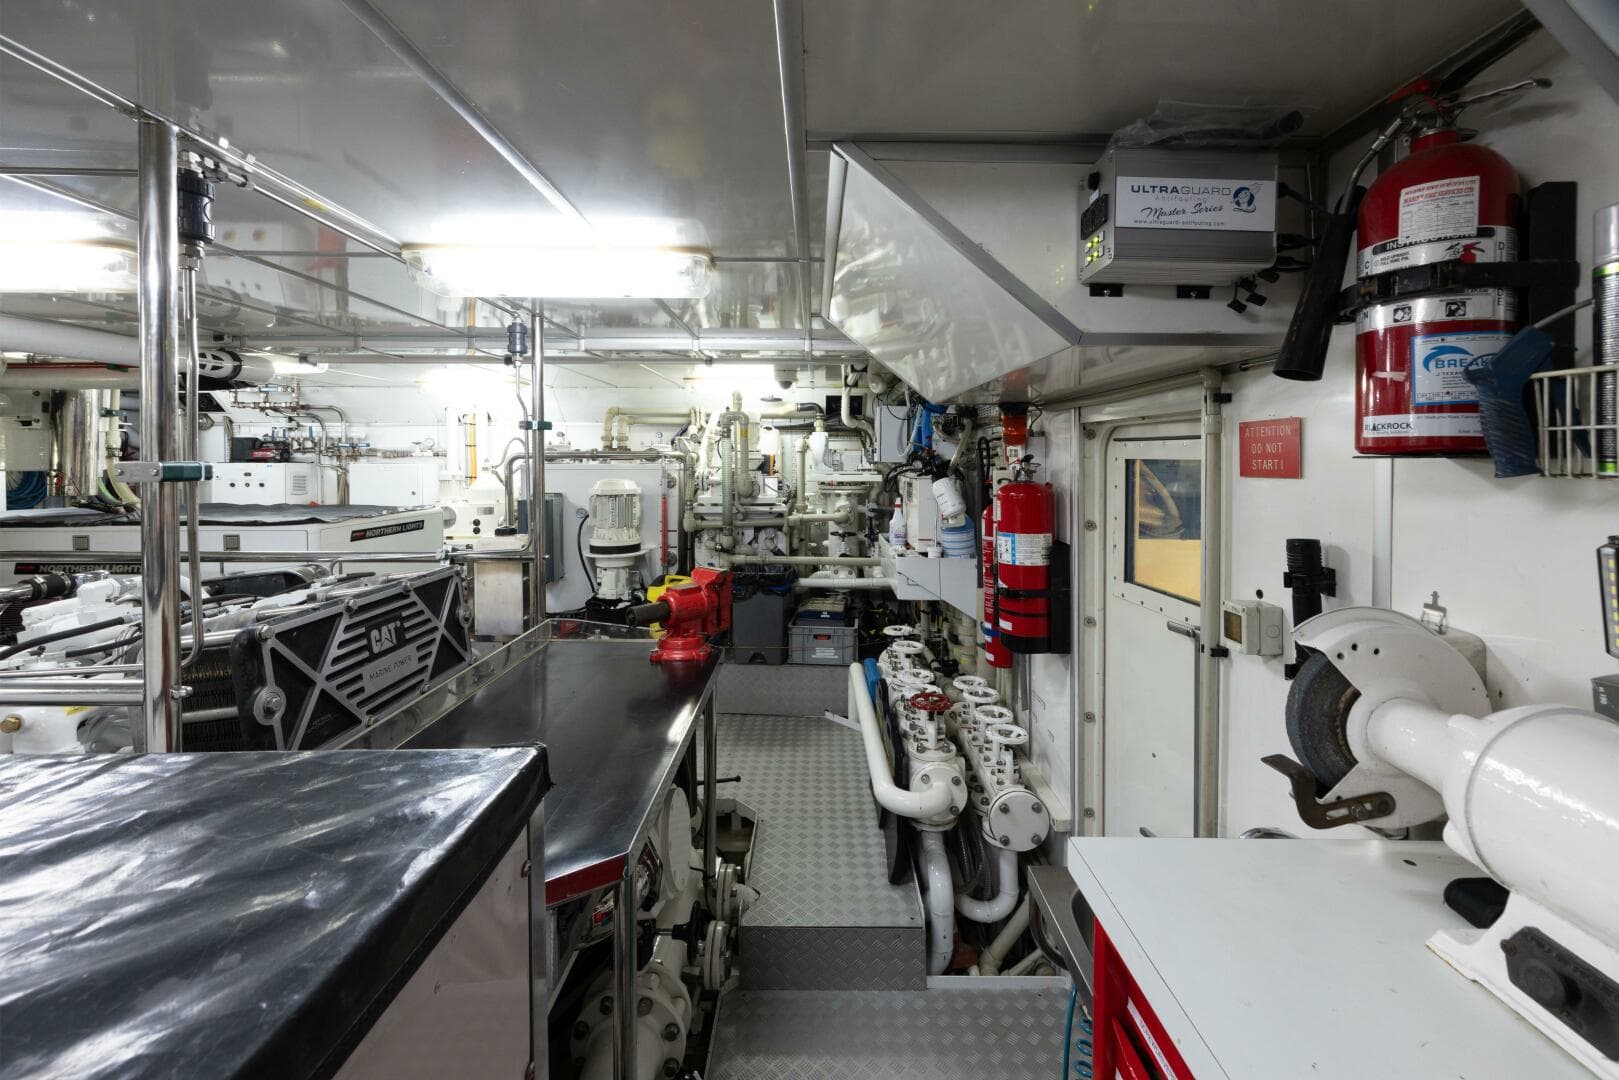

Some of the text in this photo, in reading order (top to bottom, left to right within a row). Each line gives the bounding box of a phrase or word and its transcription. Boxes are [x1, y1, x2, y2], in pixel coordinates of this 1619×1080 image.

[1131, 185, 1232, 196] ULTRAGUARD
[1140, 202, 1224, 220] Master Series
[1245, 424, 1291, 438] ATTENTION
[1251, 442, 1283, 454] DO NOT
[365, 525, 402, 538] NORTHERN
[402, 521, 424, 532] LIGHTS
[370, 622, 398, 655] CAT
[368, 655, 412, 681] MARINE POWER
